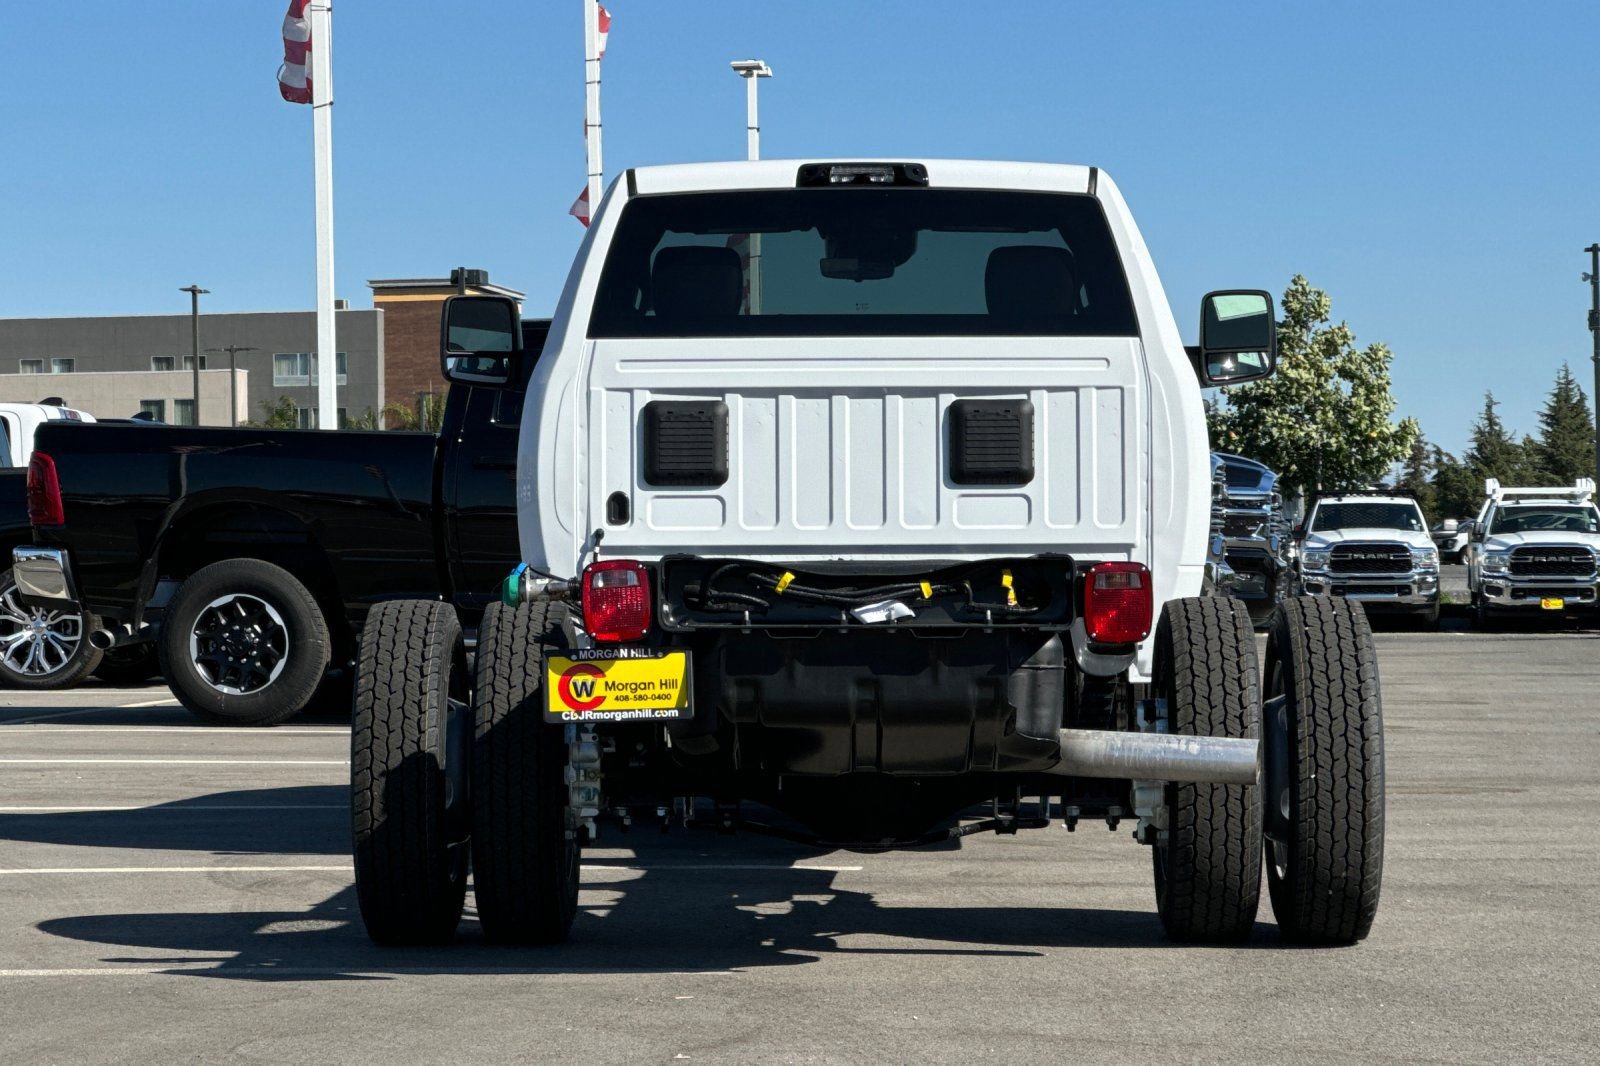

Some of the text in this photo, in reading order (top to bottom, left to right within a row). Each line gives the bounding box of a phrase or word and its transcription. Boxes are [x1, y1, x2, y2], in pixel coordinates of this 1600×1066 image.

[579, 648, 655, 660] MORGAN HILL
[605, 678, 678, 694] Morgan Hill
[614, 693, 672, 702] 408-580-0400
